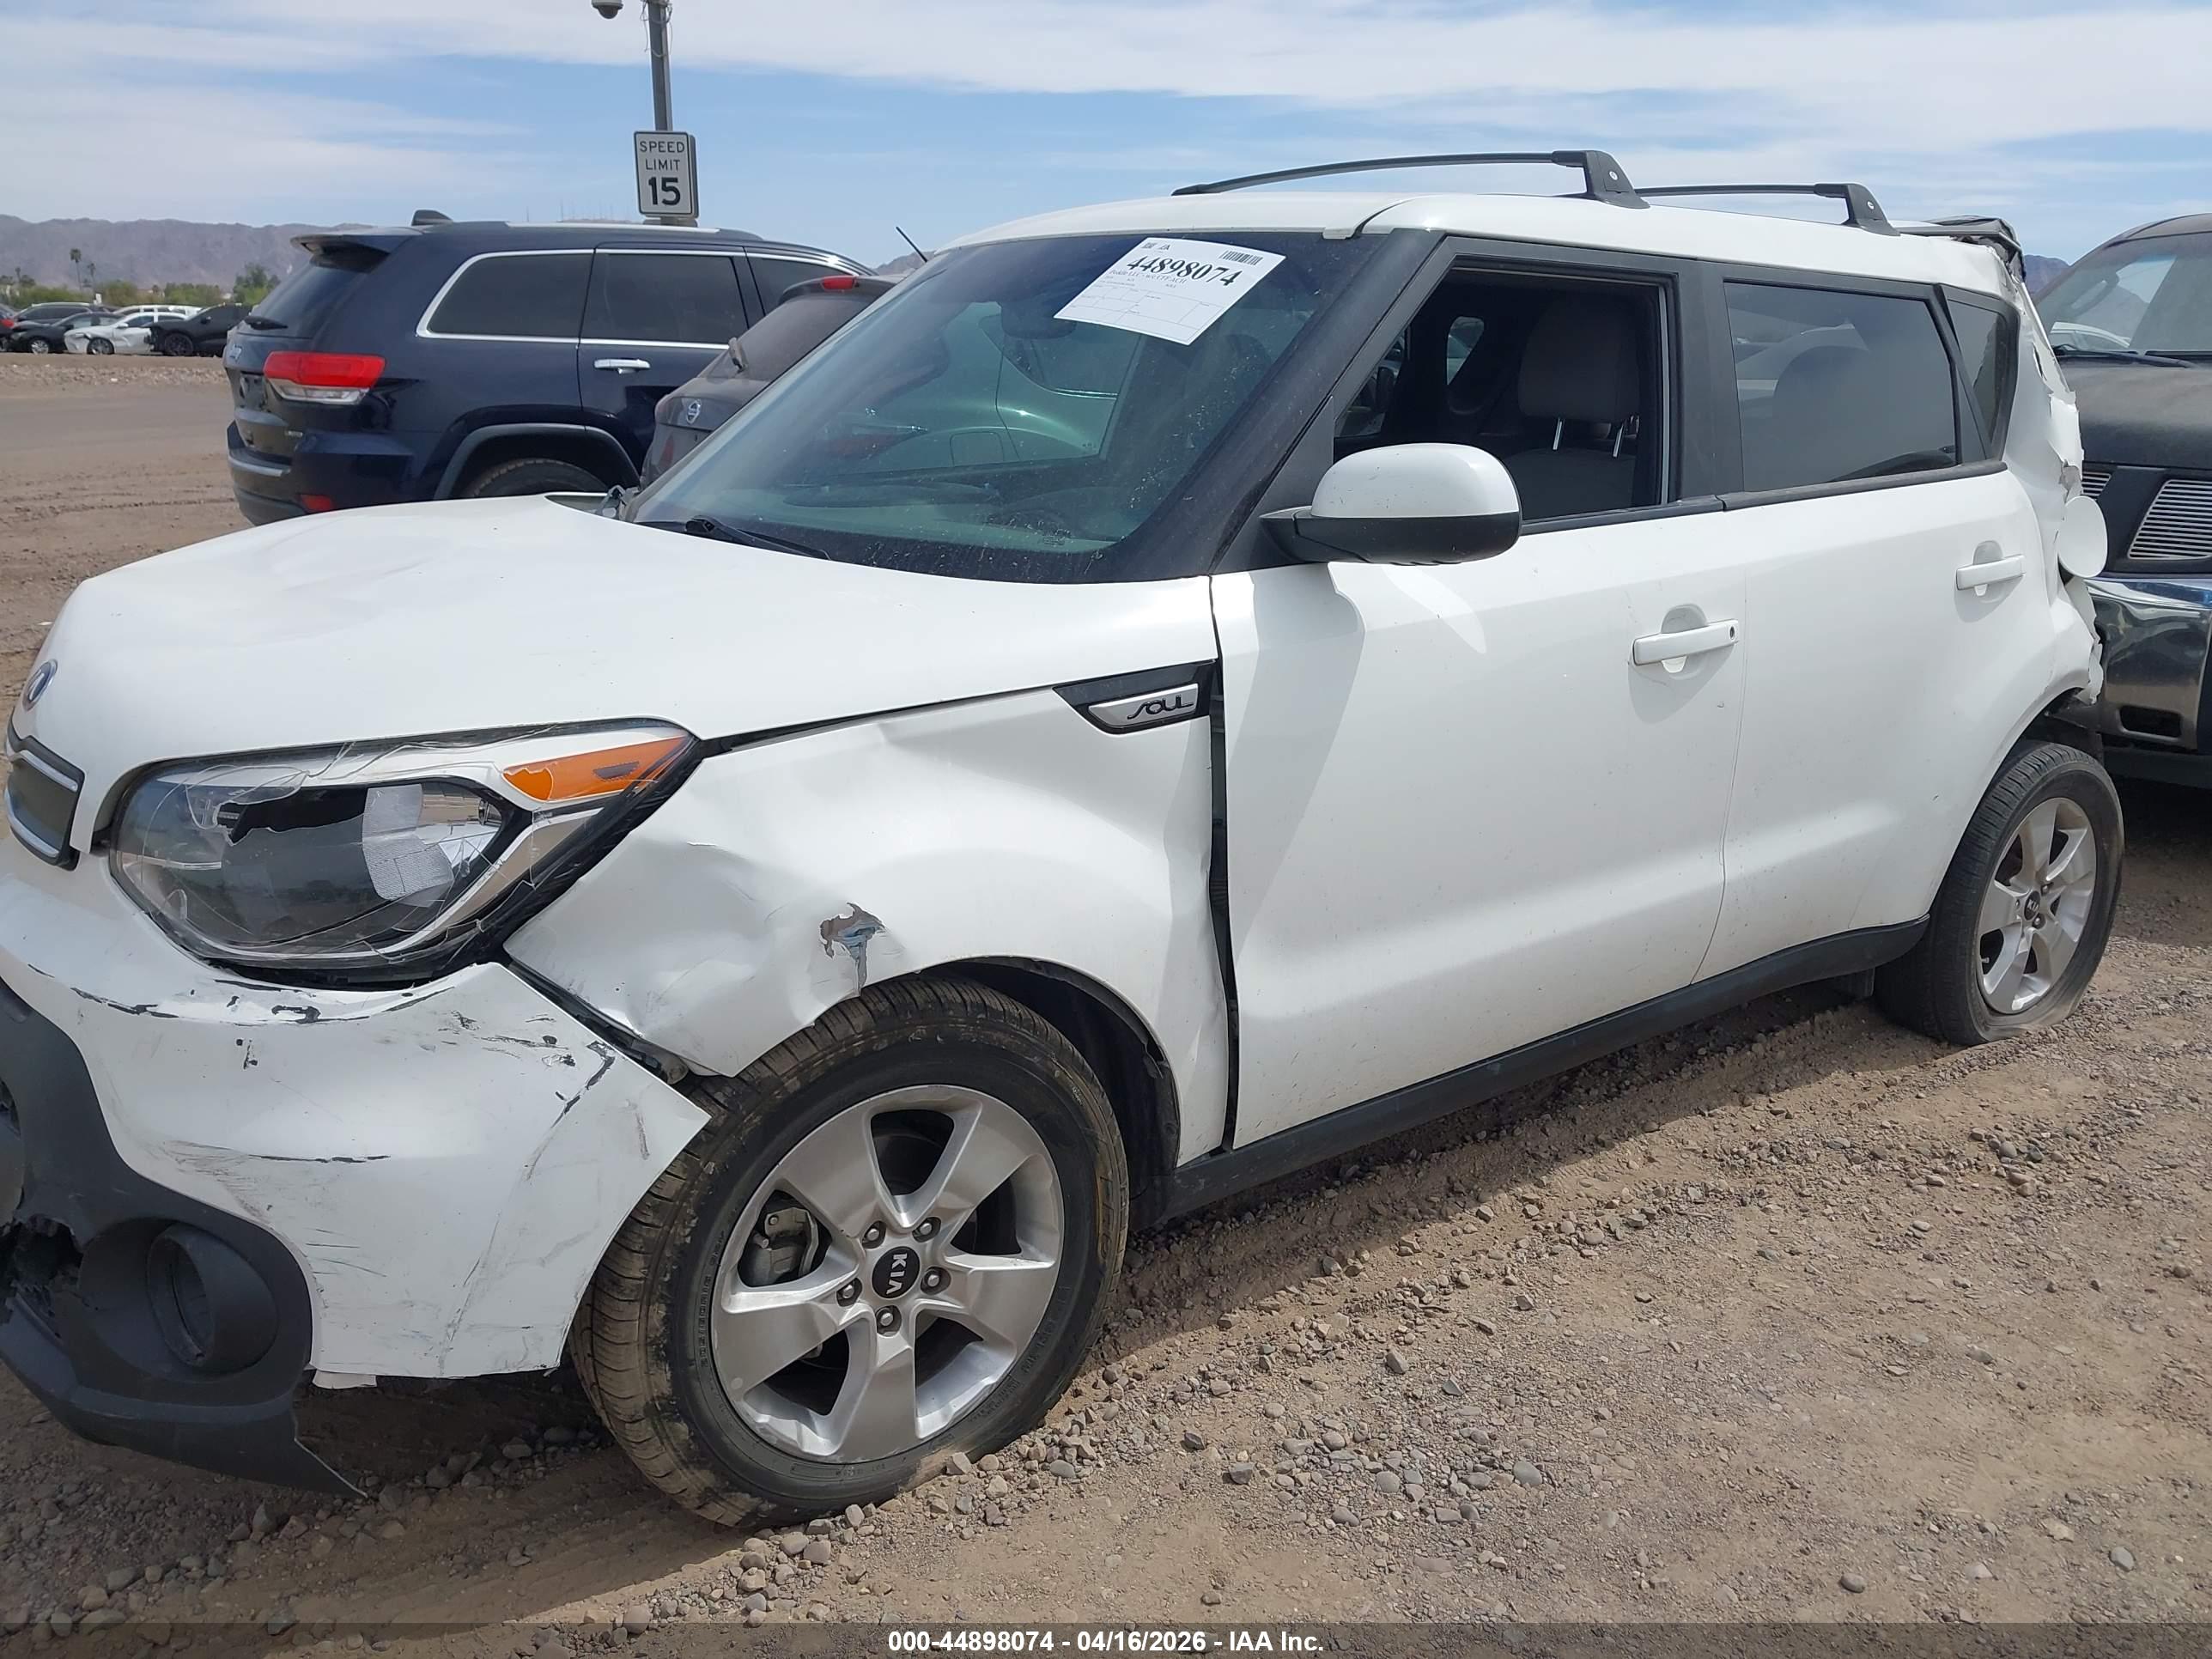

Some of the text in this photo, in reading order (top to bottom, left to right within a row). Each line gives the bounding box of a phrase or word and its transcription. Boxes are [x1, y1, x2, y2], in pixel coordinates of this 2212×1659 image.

[639, 141, 685, 153] SPEED
[645, 158, 681, 171] LIMIT
[648, 176, 681, 206] 15
[1127, 256, 1243, 286] 44898074
[1127, 695, 1194, 720] SOUL
[885, 1253, 908, 1295] KIA
